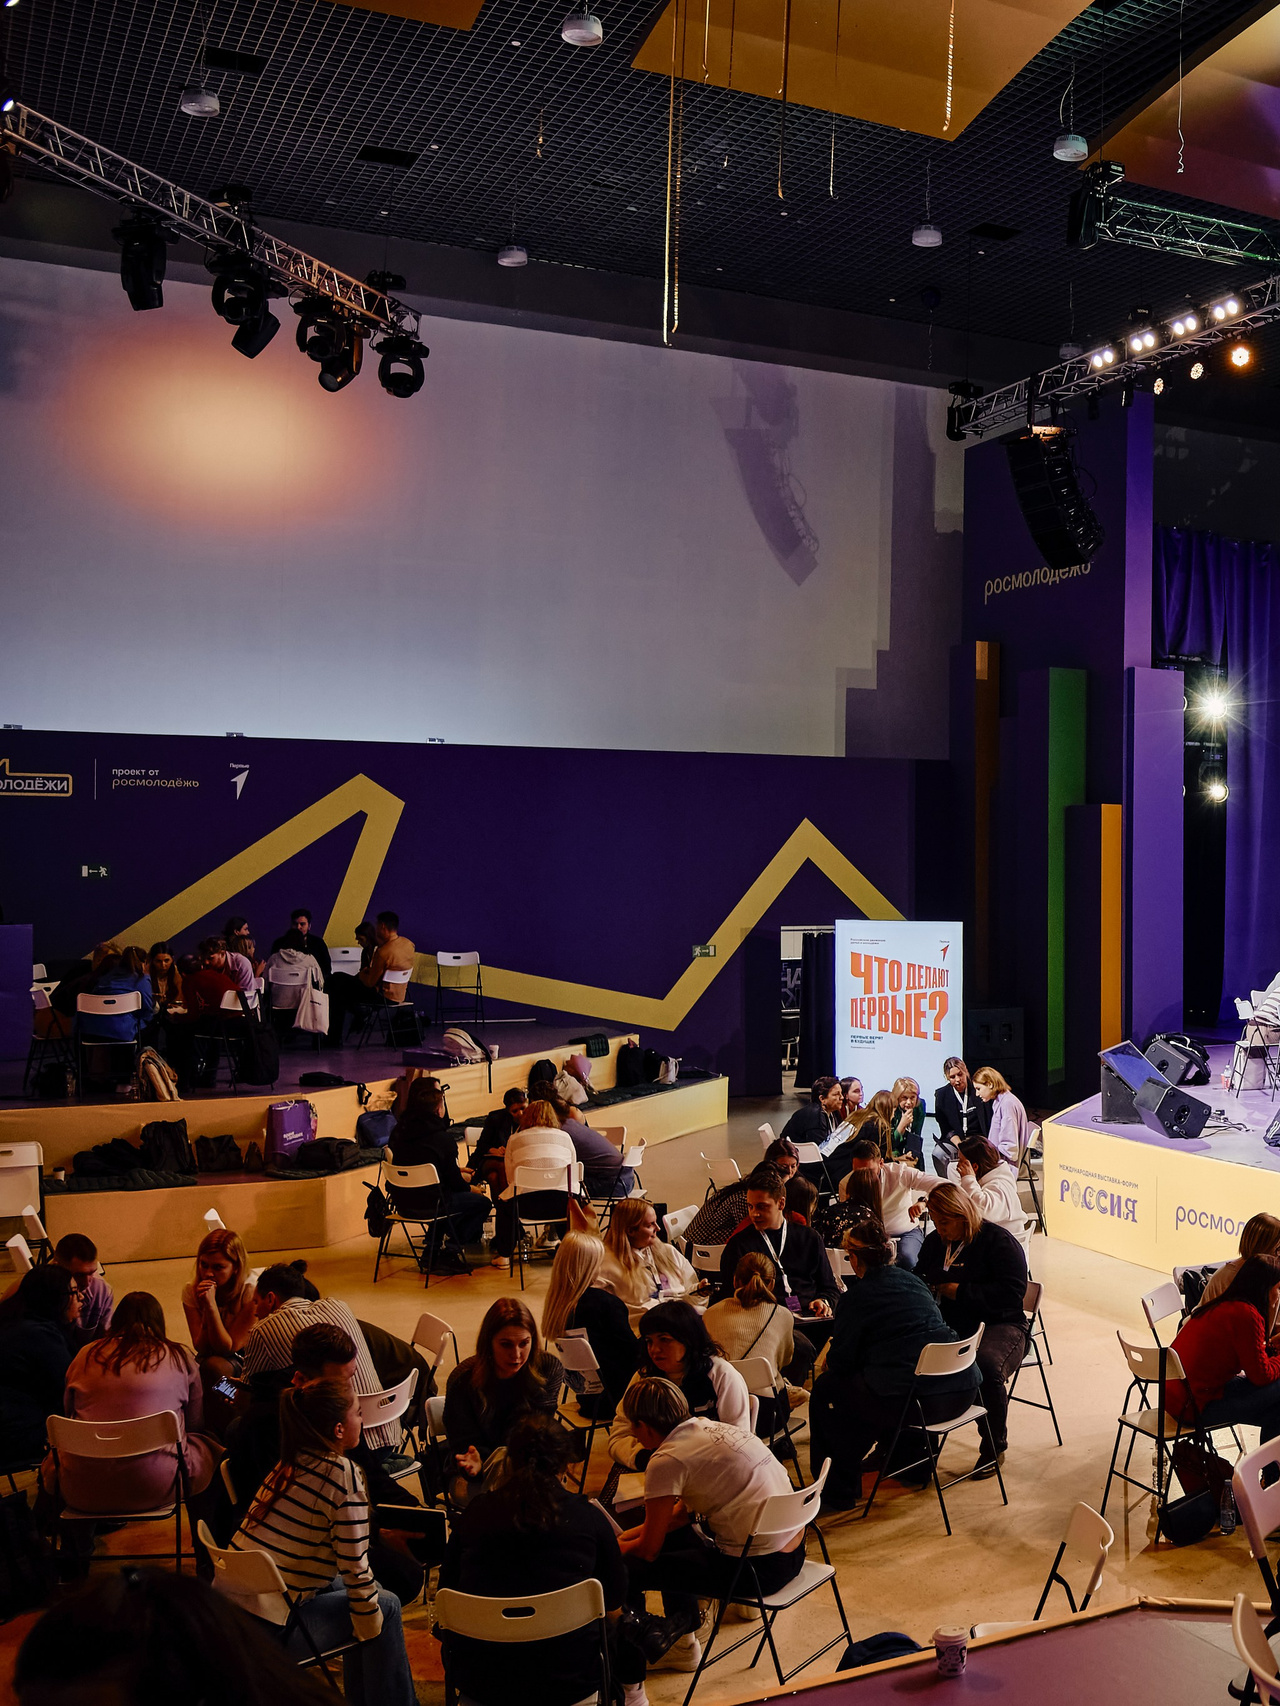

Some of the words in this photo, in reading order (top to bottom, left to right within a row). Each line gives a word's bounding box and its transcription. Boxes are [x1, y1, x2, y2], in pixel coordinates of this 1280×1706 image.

[111, 767, 147, 778] проект
[148, 768, 160, 777] от
[111, 777, 200, 790] росмолодёжь
[850, 951, 903, 996] ЧТО
[905, 962, 950, 992] ДЕЛАЮТ
[850, 990, 949, 1042] ПЕРВЫЕ?
[1059, 1163, 1097, 1179] МЕЖДУНАРОДНАЯ
[1059, 1179, 1138, 1224] РОССИЯ
